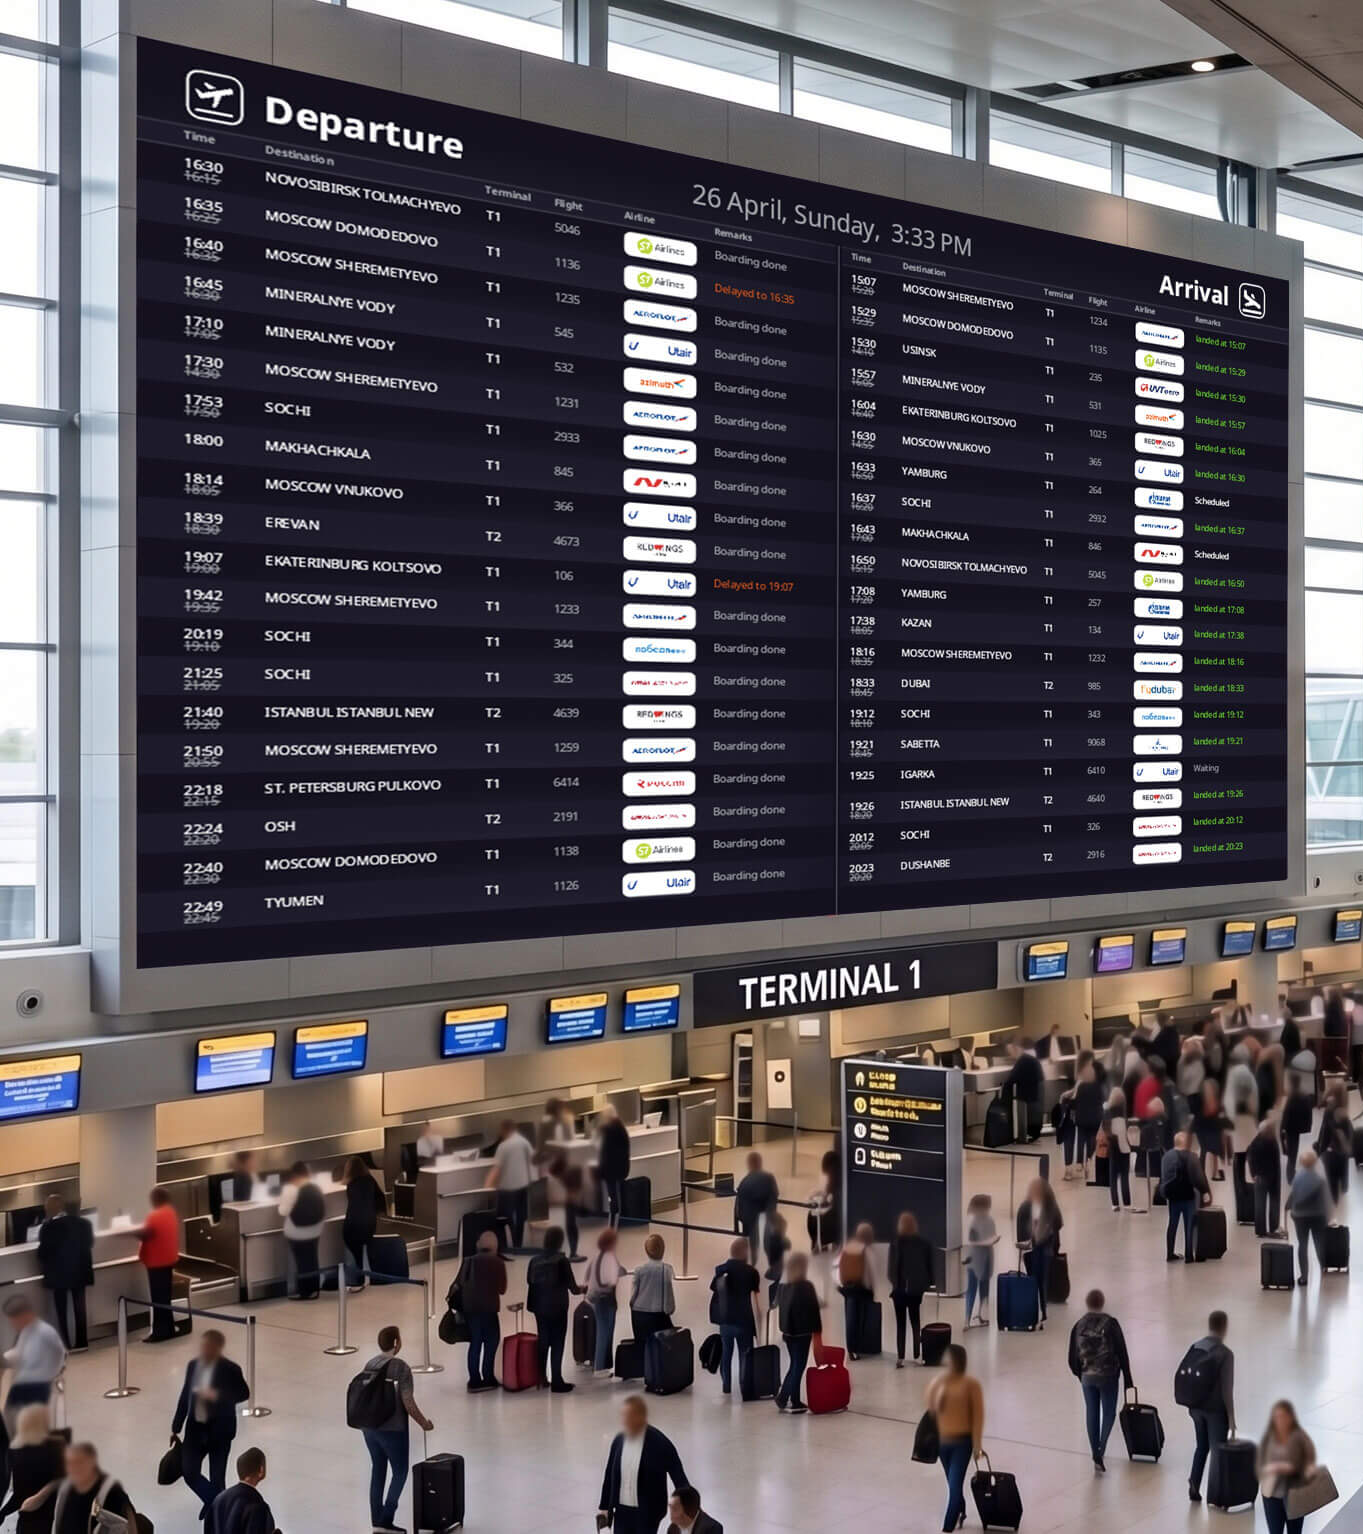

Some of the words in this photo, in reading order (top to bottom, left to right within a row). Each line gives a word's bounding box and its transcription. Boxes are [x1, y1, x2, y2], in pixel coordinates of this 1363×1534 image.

[266, 96, 464, 159] Departure
[184, 130, 215, 144] Time
[266, 145, 334, 166] Destination
[485, 185, 531, 201] Terminal
[555, 199, 582, 211] Flight
[624, 212, 655, 224] Airline
[715, 228, 752, 241] Remarks
[184, 157, 223, 174] 16:30
[266, 172, 360, 197] NOVOSIBIRSK
[363, 189, 461, 214] TOLMACHYEVO
[555, 222, 580, 235] 5046
[715, 250, 760, 268] Boarding
[762, 260, 787, 271] done
[693, 185, 721, 208] 26
[727, 192, 786, 224] April,
[795, 205, 879, 243] Sunday,
[892, 224, 935, 249] 3:33
[942, 233, 971, 256] PM
[184, 197, 223, 213] 16:35
[266, 210, 332, 230] MOSCOW
[336, 222, 438, 247] DOMODEDOVO
[556, 258, 580, 270] 1136
[715, 283, 754, 298] Delayed
[756, 292, 767, 300] to
[771, 293, 794, 304] 16:35
[184, 236, 223, 252] 16:40
[266, 249, 331, 267] MOSCOW
[335, 259, 438, 283] SHEREMETYEVO
[184, 276, 223, 291] 16:45
[266, 287, 353, 308] MINERALNYE
[357, 300, 395, 314] VODY
[1160, 276, 1228, 306] Arrival
[184, 315, 223, 330] 17:10
[266, 326, 353, 346] MINERALNYE
[357, 337, 395, 350] VODY
[903, 344, 936, 357] USINSK
[184, 354, 223, 369] 17:30
[266, 364, 331, 380] MOSCOW
[335, 372, 438, 392] SHEREMETYEVO
[184, 394, 223, 408] 17:53
[265, 402, 310, 416] SOCHI
[554, 432, 580, 443] 2933
[184, 433, 223, 447] 18:00
[266, 441, 370, 459] MAKHACHKALA
[266, 479, 331, 493] MOSCOW
[335, 484, 403, 498] VNUKOVO
[902, 467, 947, 479] YAMBURG
[1195, 497, 1229, 507] Scheduled
[902, 497, 931, 508] SOCHI
[266, 517, 319, 530] EREVAN
[902, 528, 969, 541] MAKHACHKALA
[266, 555, 368, 570] EKATERINBURG
[373, 561, 441, 574] KOLTSOVO
[714, 579, 753, 591] Delayed
[769, 582, 793, 591] 19:07
[266, 592, 331, 604] MOSCOW
[335, 595, 437, 609] SHEREMETYEVO
[902, 619, 931, 627] KAZAN
[265, 631, 310, 642] SOCHI
[265, 669, 310, 679] SOCHI
[902, 679, 930, 688] DUBAI
[184, 706, 223, 718] 21:40
[265, 707, 333, 717] ISTANBUL
[337, 707, 402, 717] ISTANBUL
[405, 708, 434, 717] NEW
[266, 745, 331, 755] MOSCOW
[335, 744, 437, 755] SHEREMETYEVO
[901, 740, 940, 748] SABETTA
[901, 770, 935, 779] IGARKA
[1194, 764, 1219, 773] Waiting
[265, 783, 285, 794] ST.
[290, 781, 375, 793] PETERSBURG
[378, 780, 441, 791] PULKOVO
[265, 821, 295, 832] OSH
[265, 858, 331, 870] MOSCOW
[335, 853, 437, 867] DOMODEDOVO
[901, 859, 950, 870] DUSHANBE
[184, 901, 223, 914] 22:49
[265, 896, 323, 908] TYUMEN
[739, 963, 898, 1008] TERMINAL
[908, 959, 921, 990] 1
